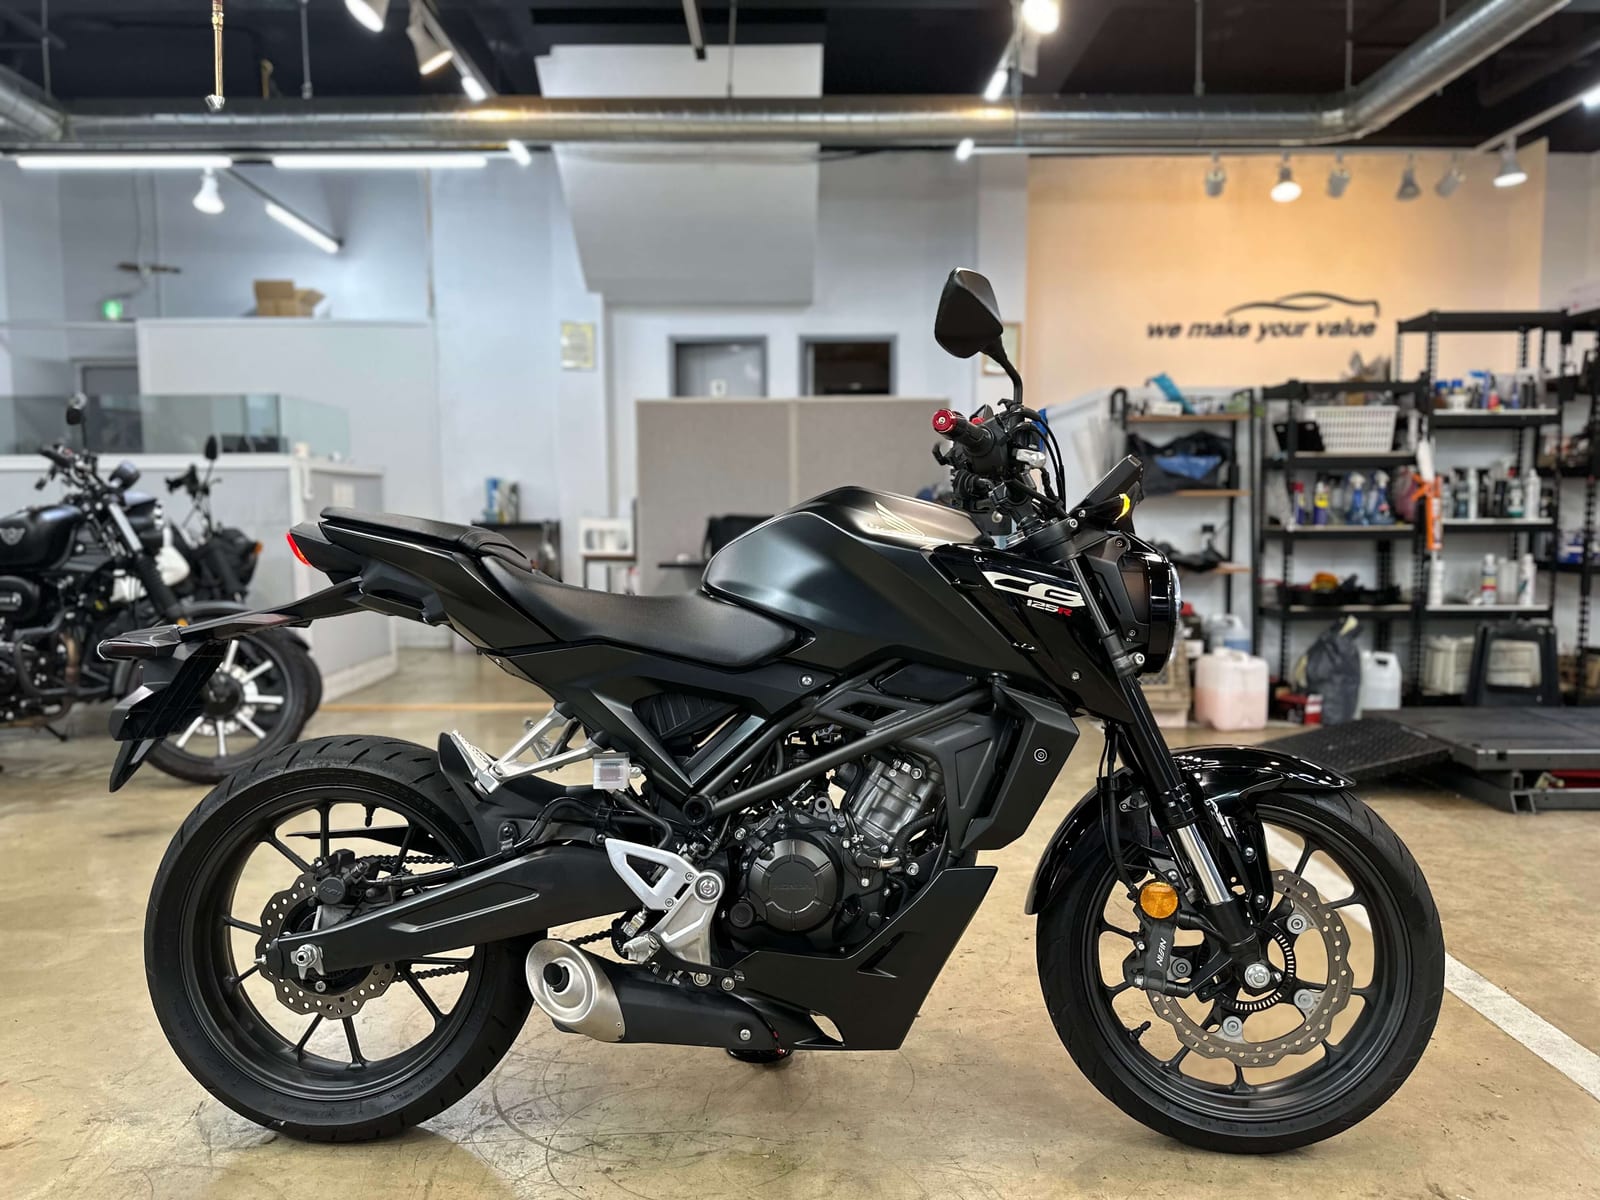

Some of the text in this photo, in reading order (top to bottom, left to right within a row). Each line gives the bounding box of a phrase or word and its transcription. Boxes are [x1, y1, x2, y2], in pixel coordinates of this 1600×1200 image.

[1147, 317, 1376, 343] we make your value
[981, 571, 1086, 608] CB
[1026, 599, 1073, 617] 125R
